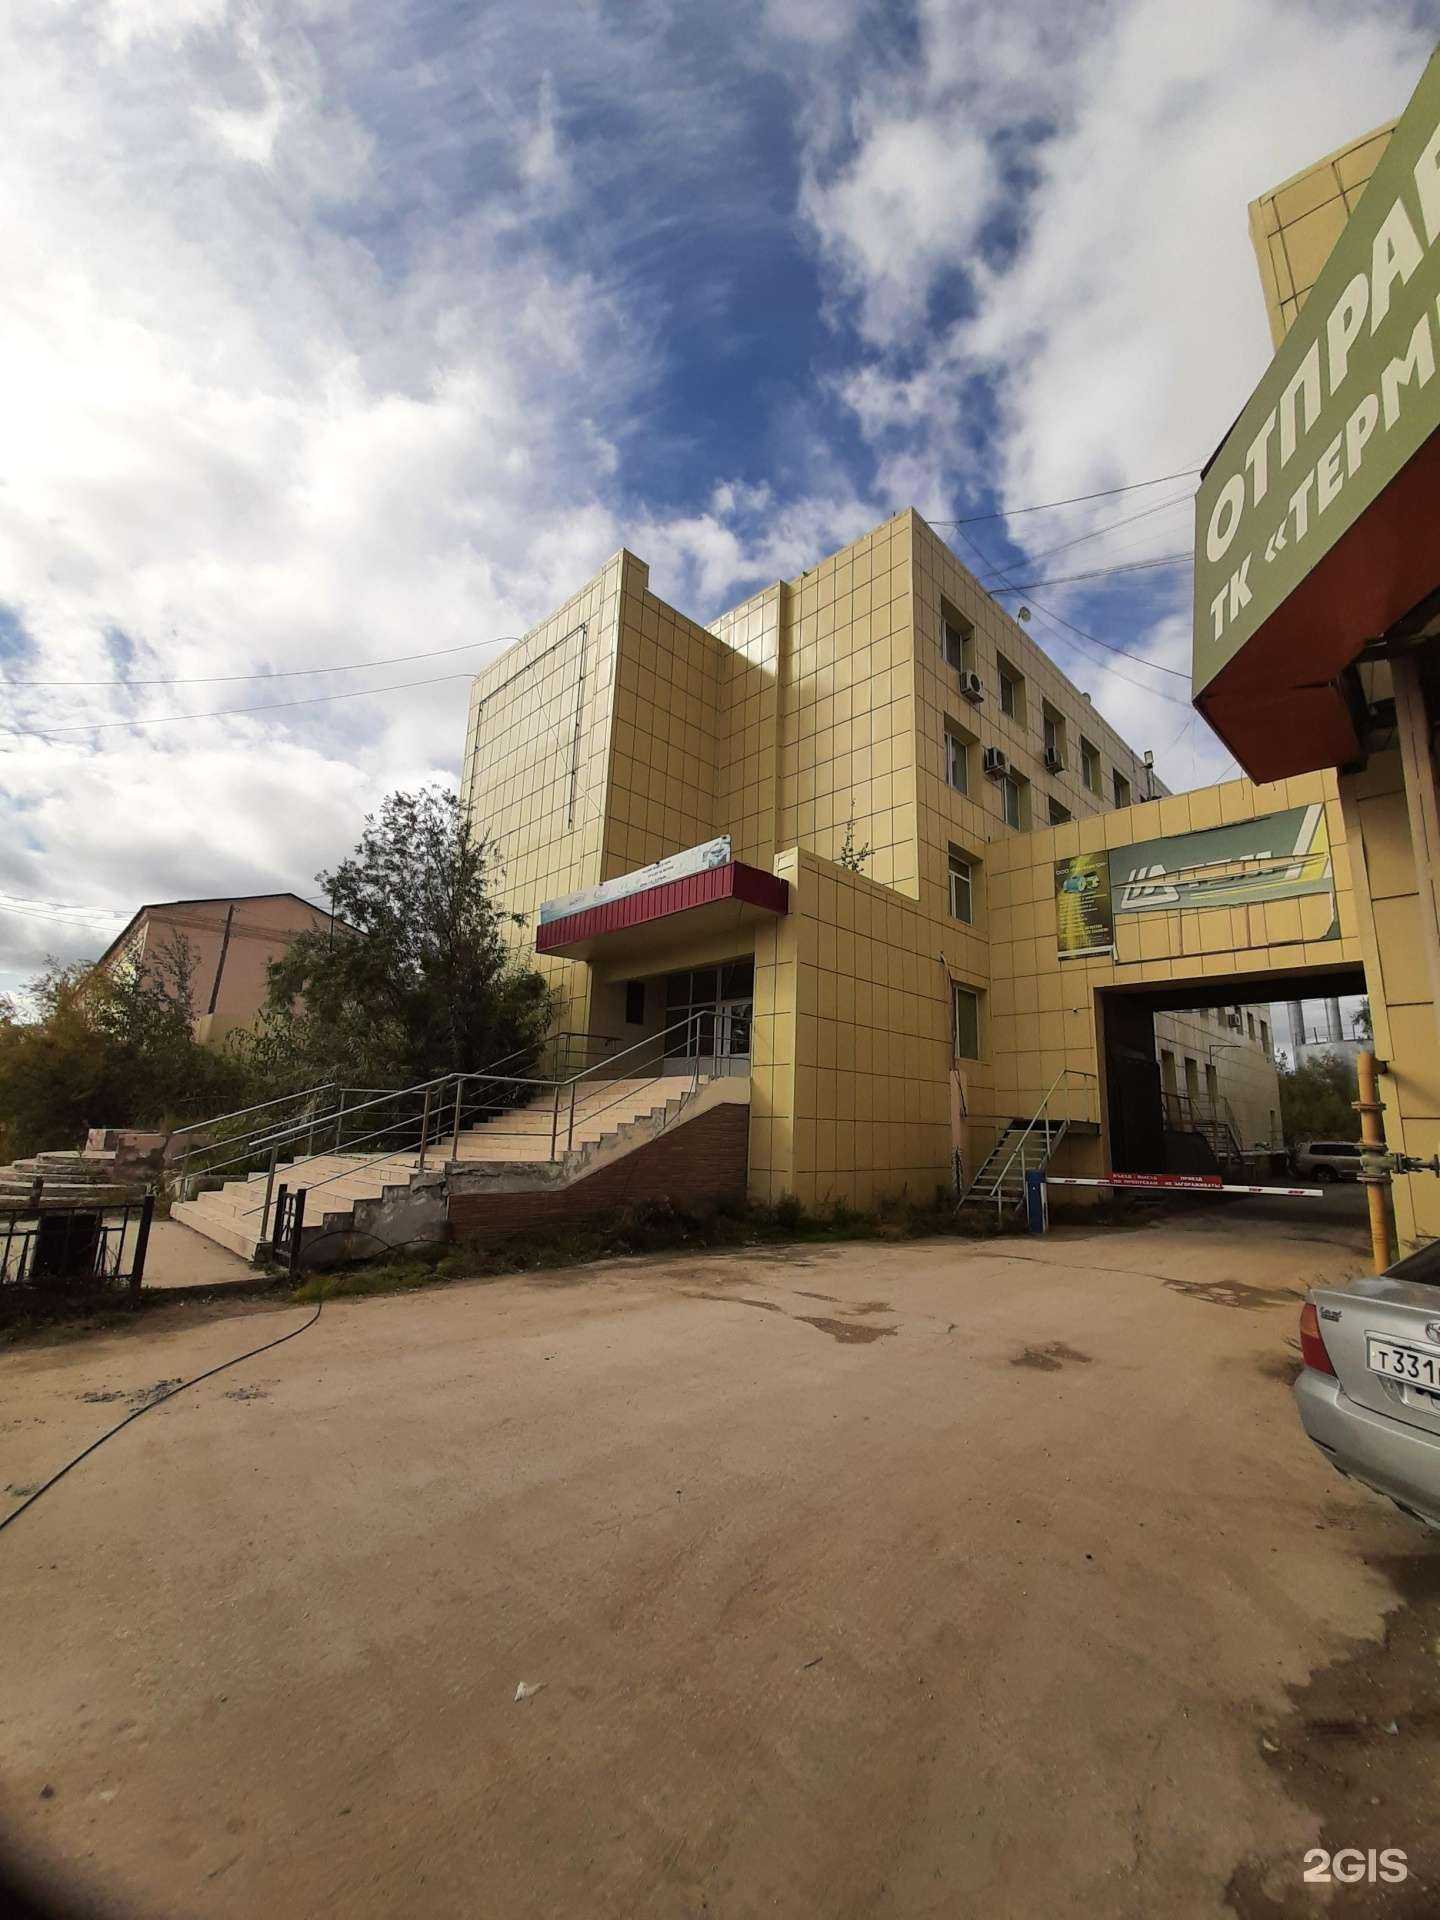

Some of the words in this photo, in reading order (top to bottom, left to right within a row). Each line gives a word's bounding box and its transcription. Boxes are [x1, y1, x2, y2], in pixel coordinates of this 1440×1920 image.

[1209, 551, 1254, 642] ТК
[1264, 293, 1440, 563] «ТЕРМ
[1378, 1350, 1440, 1386] Т331
